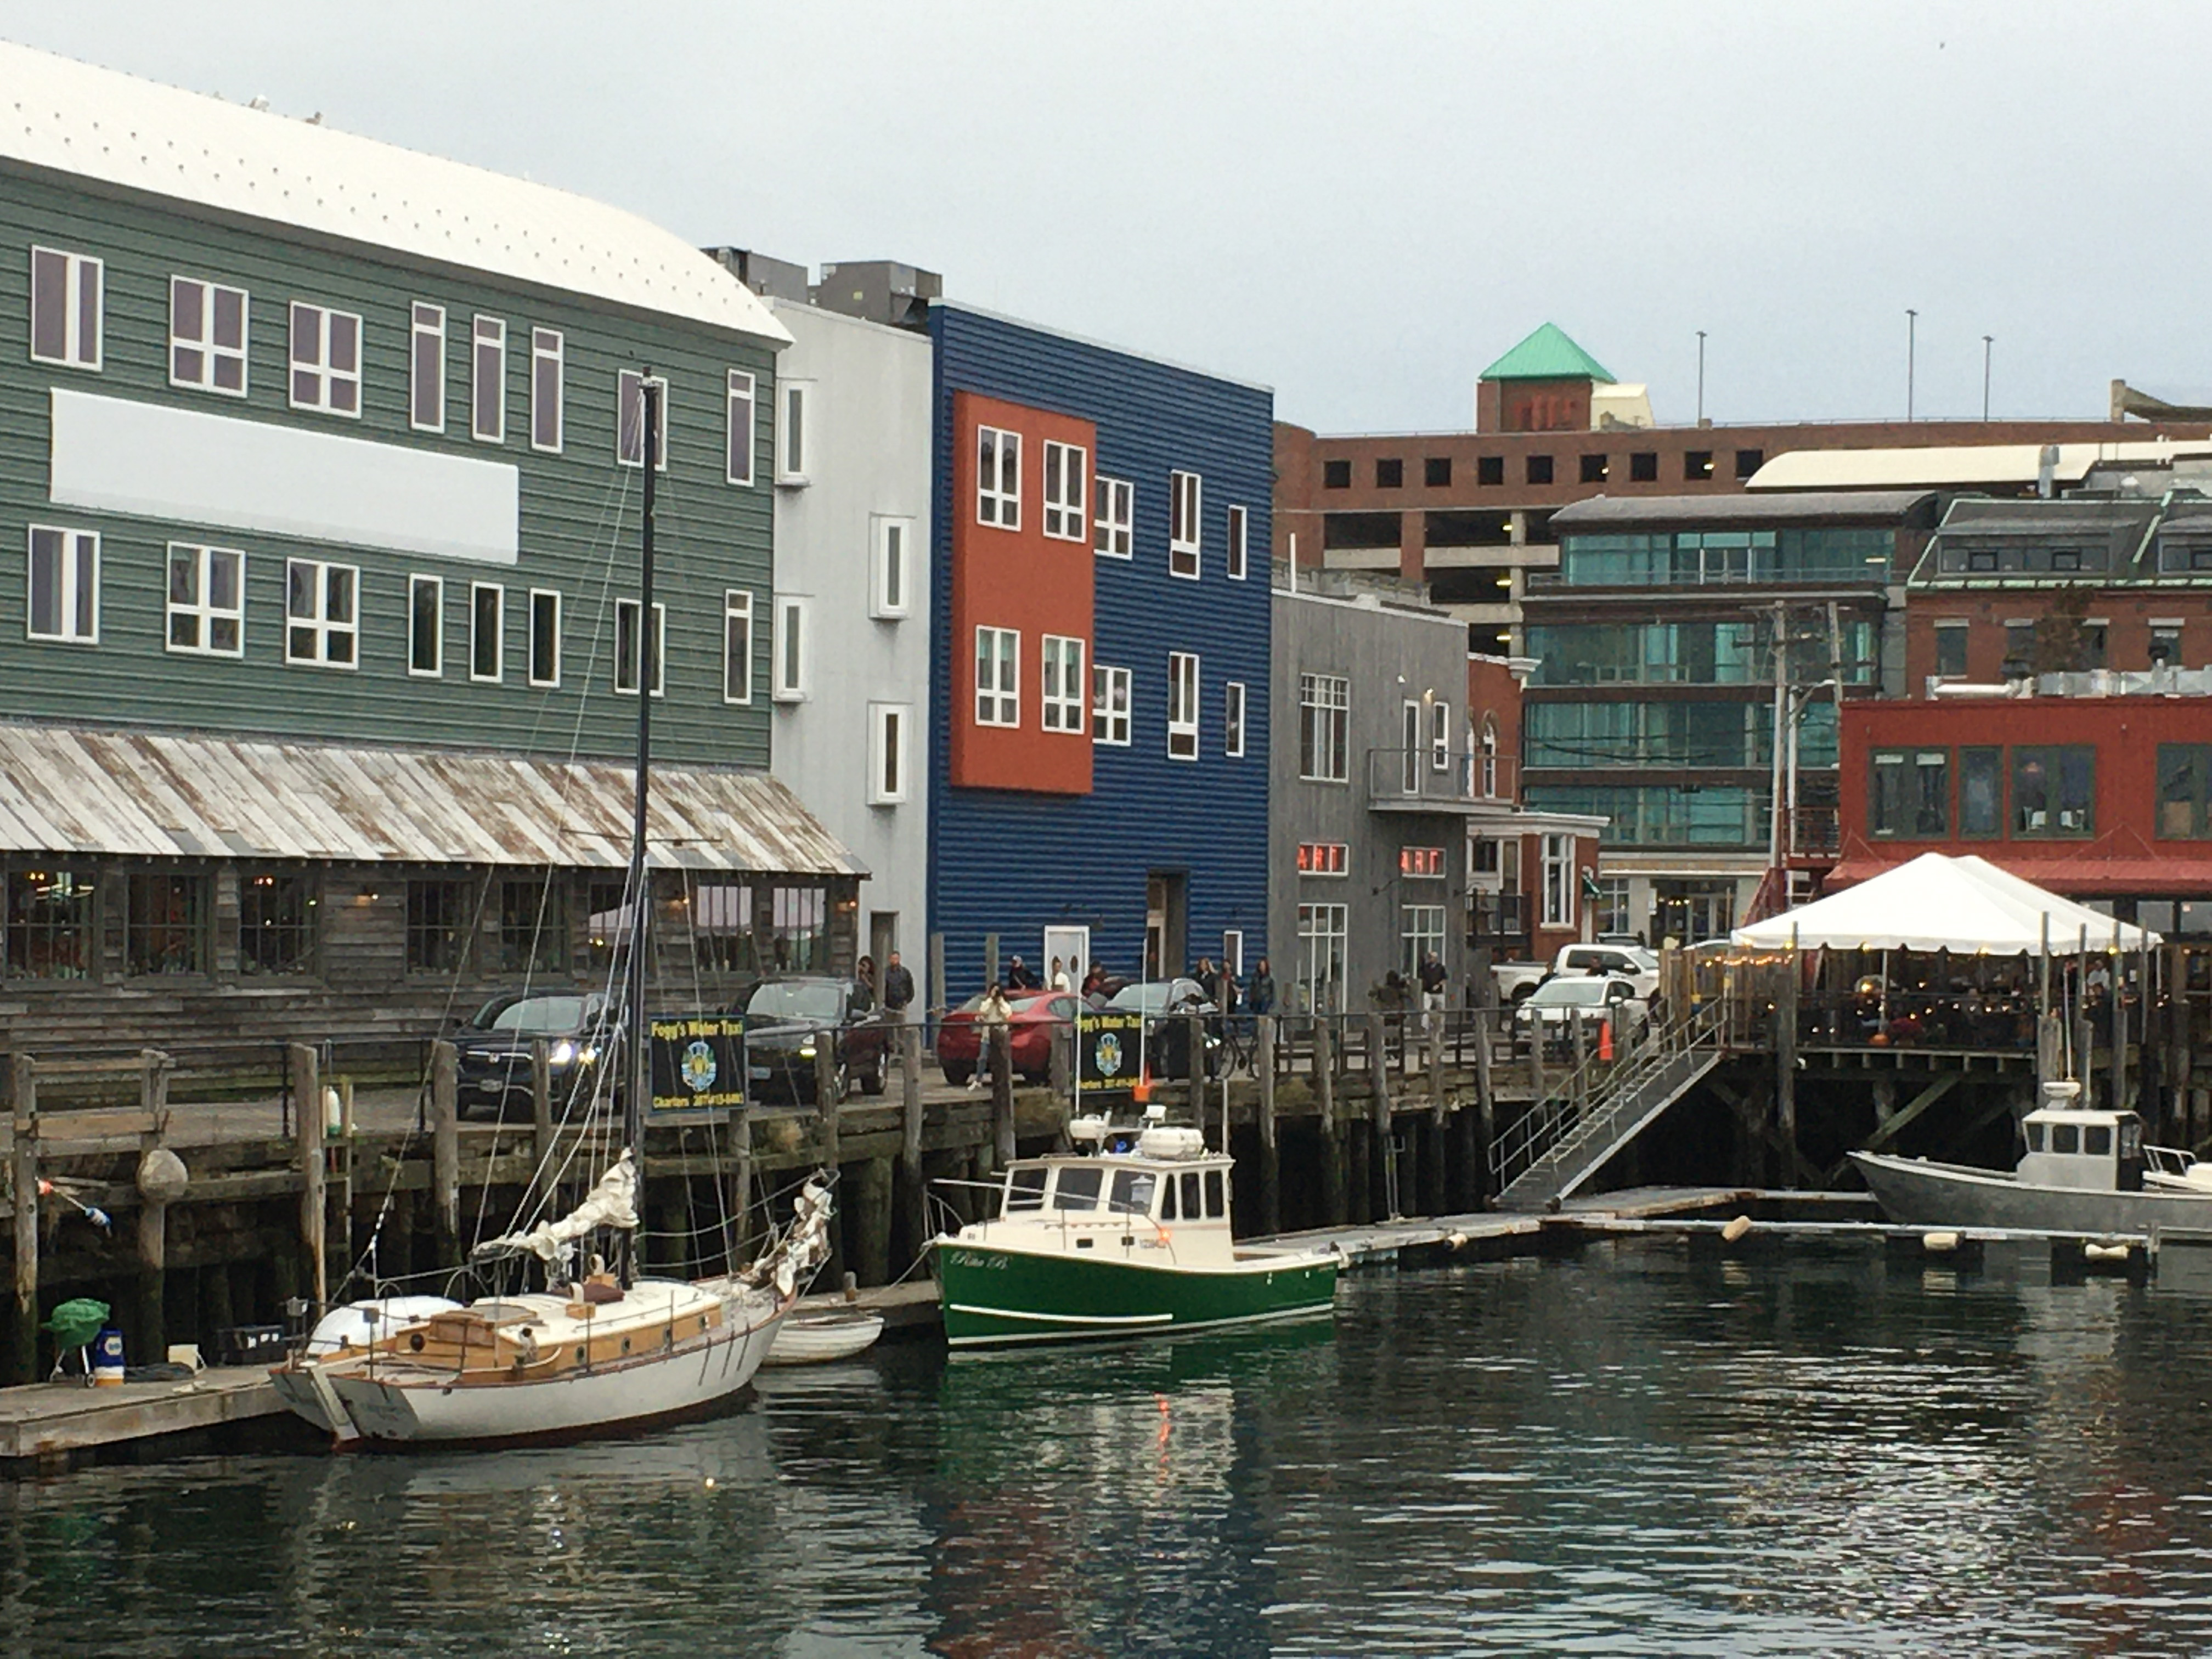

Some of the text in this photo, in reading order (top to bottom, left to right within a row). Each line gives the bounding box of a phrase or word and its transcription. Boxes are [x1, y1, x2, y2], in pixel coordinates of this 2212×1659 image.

[1401, 849, 1438, 873] ART
[652, 1020, 742, 1040] Fogg's Water Taxi
